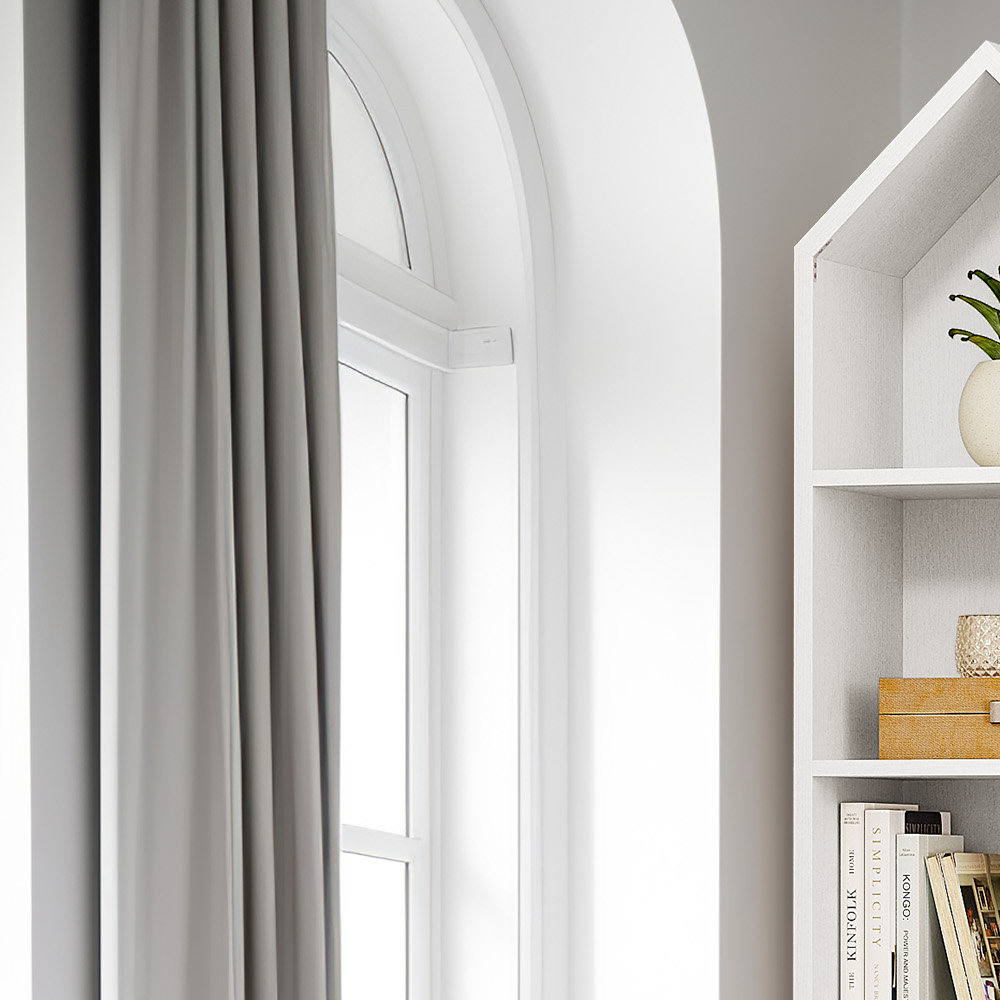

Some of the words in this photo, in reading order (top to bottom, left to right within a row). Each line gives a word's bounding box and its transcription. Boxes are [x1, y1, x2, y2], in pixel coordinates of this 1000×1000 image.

[872, 827, 881, 947] SIMPLICITY
[902, 874, 911, 921] KONGO:
[846, 889, 857, 961] KINFOLK
